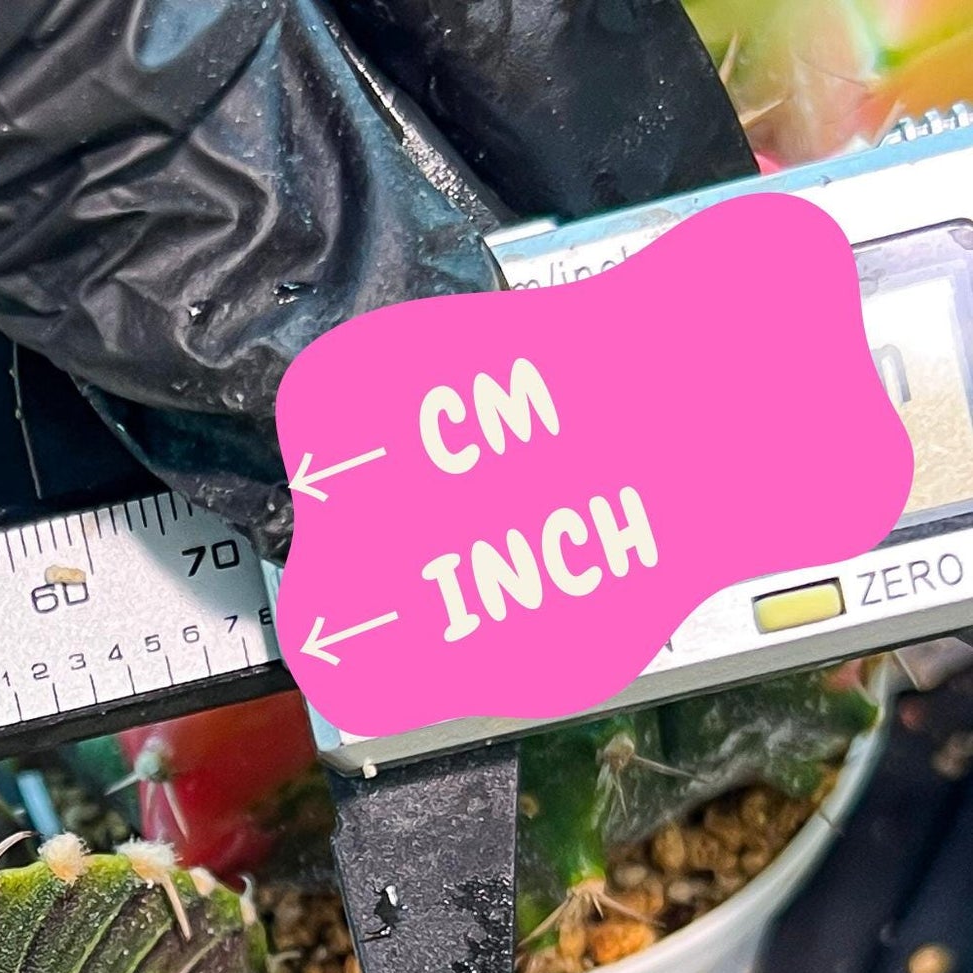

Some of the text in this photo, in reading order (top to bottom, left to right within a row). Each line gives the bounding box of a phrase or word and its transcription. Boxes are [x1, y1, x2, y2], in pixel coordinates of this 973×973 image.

[30, 580, 89, 614] 60
[181, 538, 241, 577] 70
[857, 553, 964, 605] ZERO
[2, 670, 12, 687] 1
[30, 662, 50, 681] 2
[68, 653, 87, 671] 3
[108, 643, 123, 662] 4
[144, 634, 162, 653] 5
[182, 624, 200, 644] 6
[223, 614, 239, 634] 7
